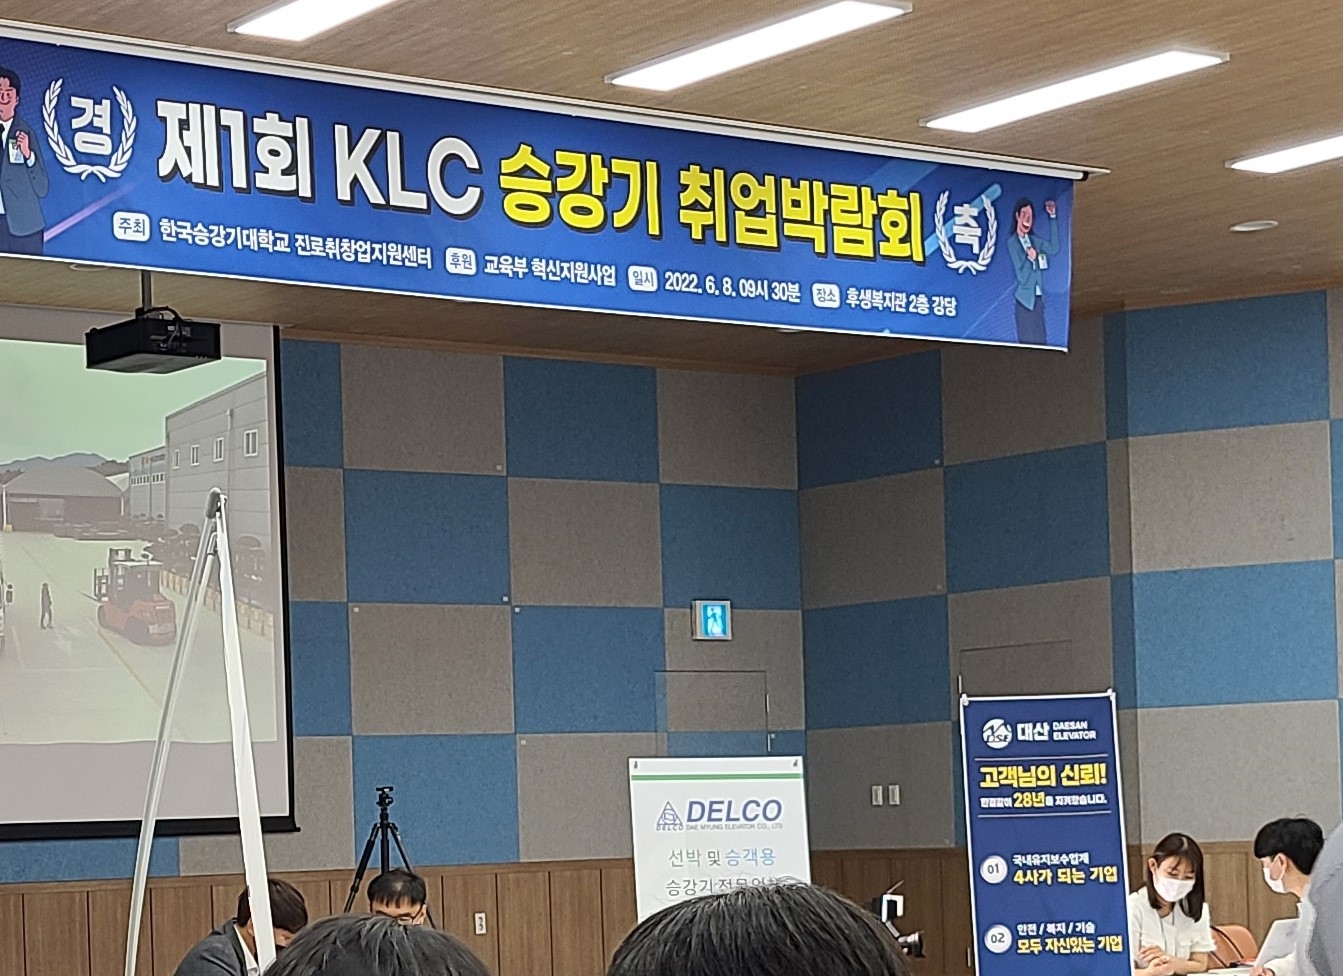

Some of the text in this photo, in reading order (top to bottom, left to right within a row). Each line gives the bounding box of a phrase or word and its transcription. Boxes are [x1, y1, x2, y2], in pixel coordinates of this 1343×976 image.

[70, 96, 113, 156] 경
[157, 98, 925, 262] 제1회 KLC 승강기 취업박람회
[952, 202, 983, 255] 축
[117, 217, 958, 317] 주최 한국승강기대학교 진로취창업지원센터 후원 교육부 혁신지원사업 일시 2022. 6. 8. 09시 30분 장소 후생복지관 2층 강당
[1016, 721, 1050, 742] 대산
[1052, 721, 1088, 731] DAESAN
[1052, 730, 1097, 741] ELEVATOR
[979, 763, 1107, 788] 고객님의 신뢰!
[686, 799, 783, 823] DELCO
[669, 847, 776, 868] 선박 및 승객용
[1012, 851, 1090, 867] 국내유지보수업계
[987, 863, 1000, 875] 01
[1013, 865, 1118, 885] 4사가 되는 기업
[665, 878, 714, 897] 승강기
[990, 932, 1005, 944] 02
[1016, 923, 1037, 936] 안전
[1075, 921, 1096, 934] 기술
[1017, 934, 1123, 955] 모두 자신있는 기업
